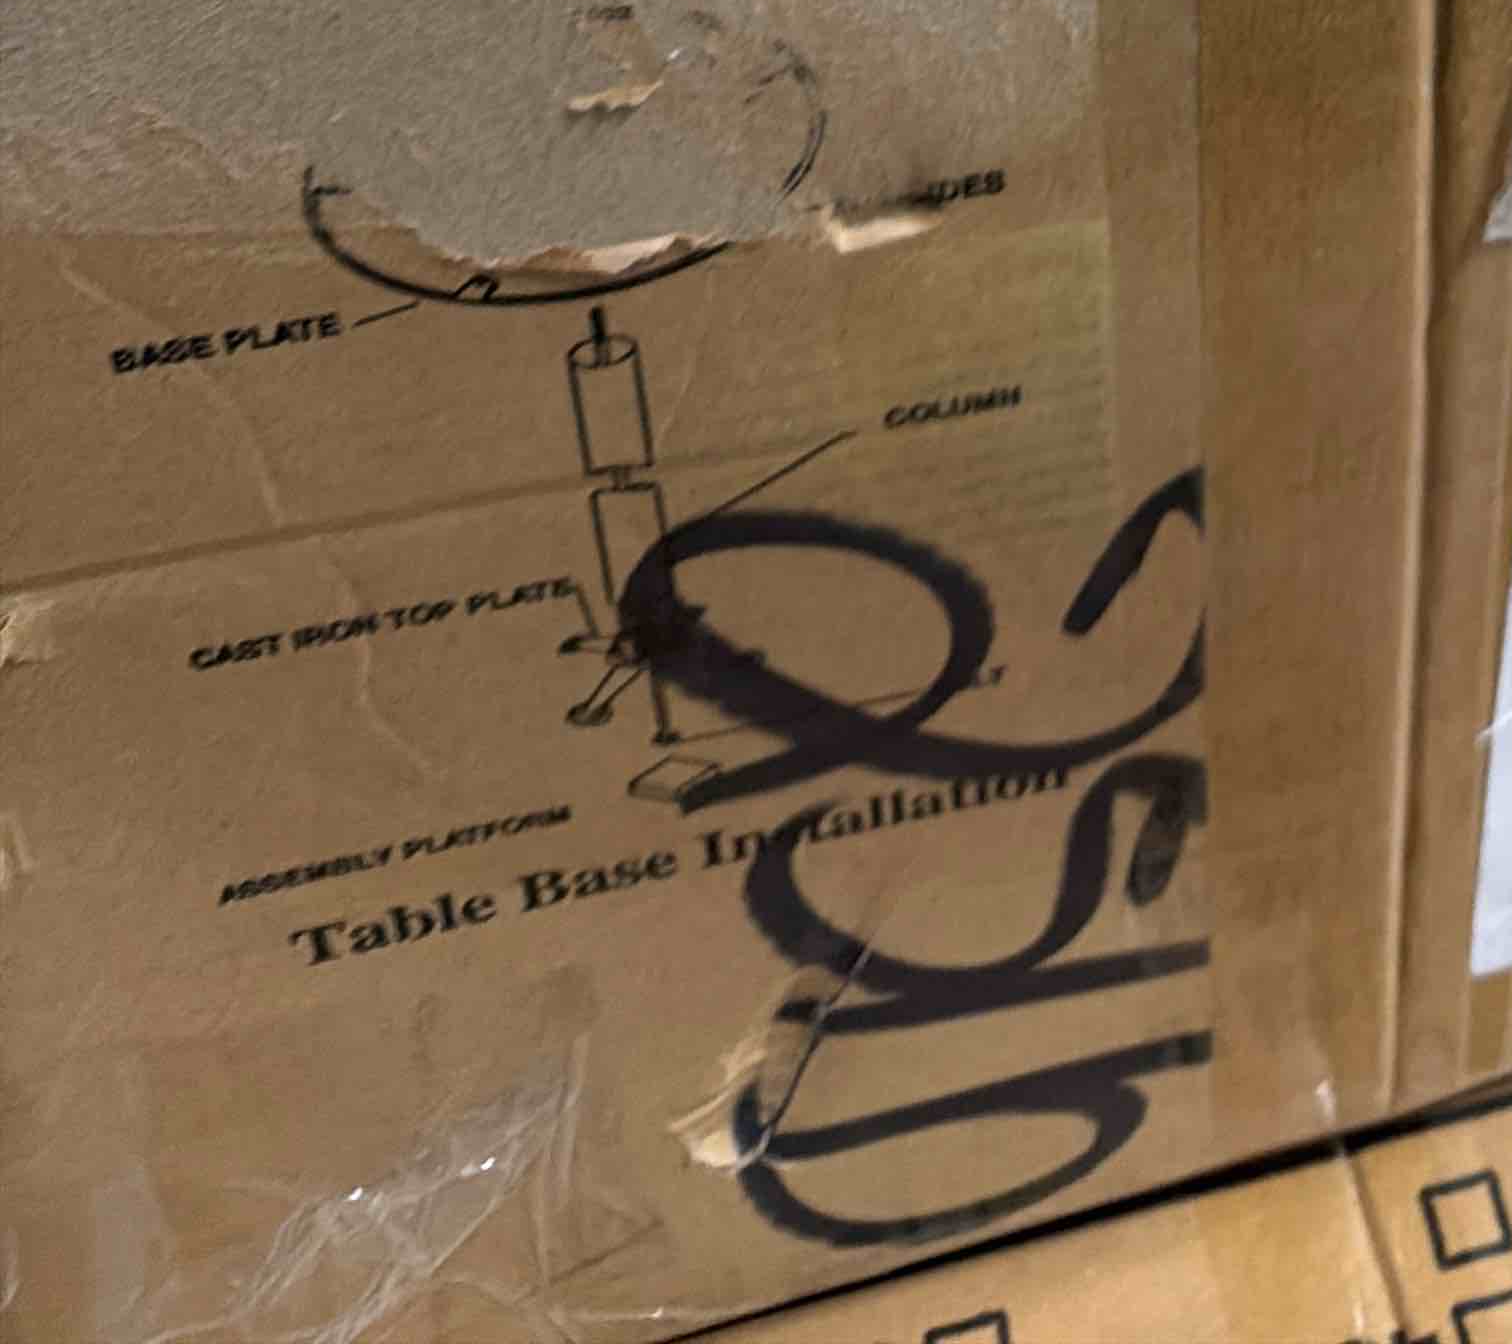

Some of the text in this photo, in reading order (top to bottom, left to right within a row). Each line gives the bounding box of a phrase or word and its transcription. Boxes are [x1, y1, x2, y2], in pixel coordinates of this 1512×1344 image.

[108, 312, 343, 376] BASE PLATE
[883, 383, 1023, 433] COLUMN
[188, 576, 576, 671] CAST IRON TOP PLATE
[218, 805, 573, 908] ASSEMBLY PLATFORM
[287, 766, 1076, 969] Table Base Intallation
